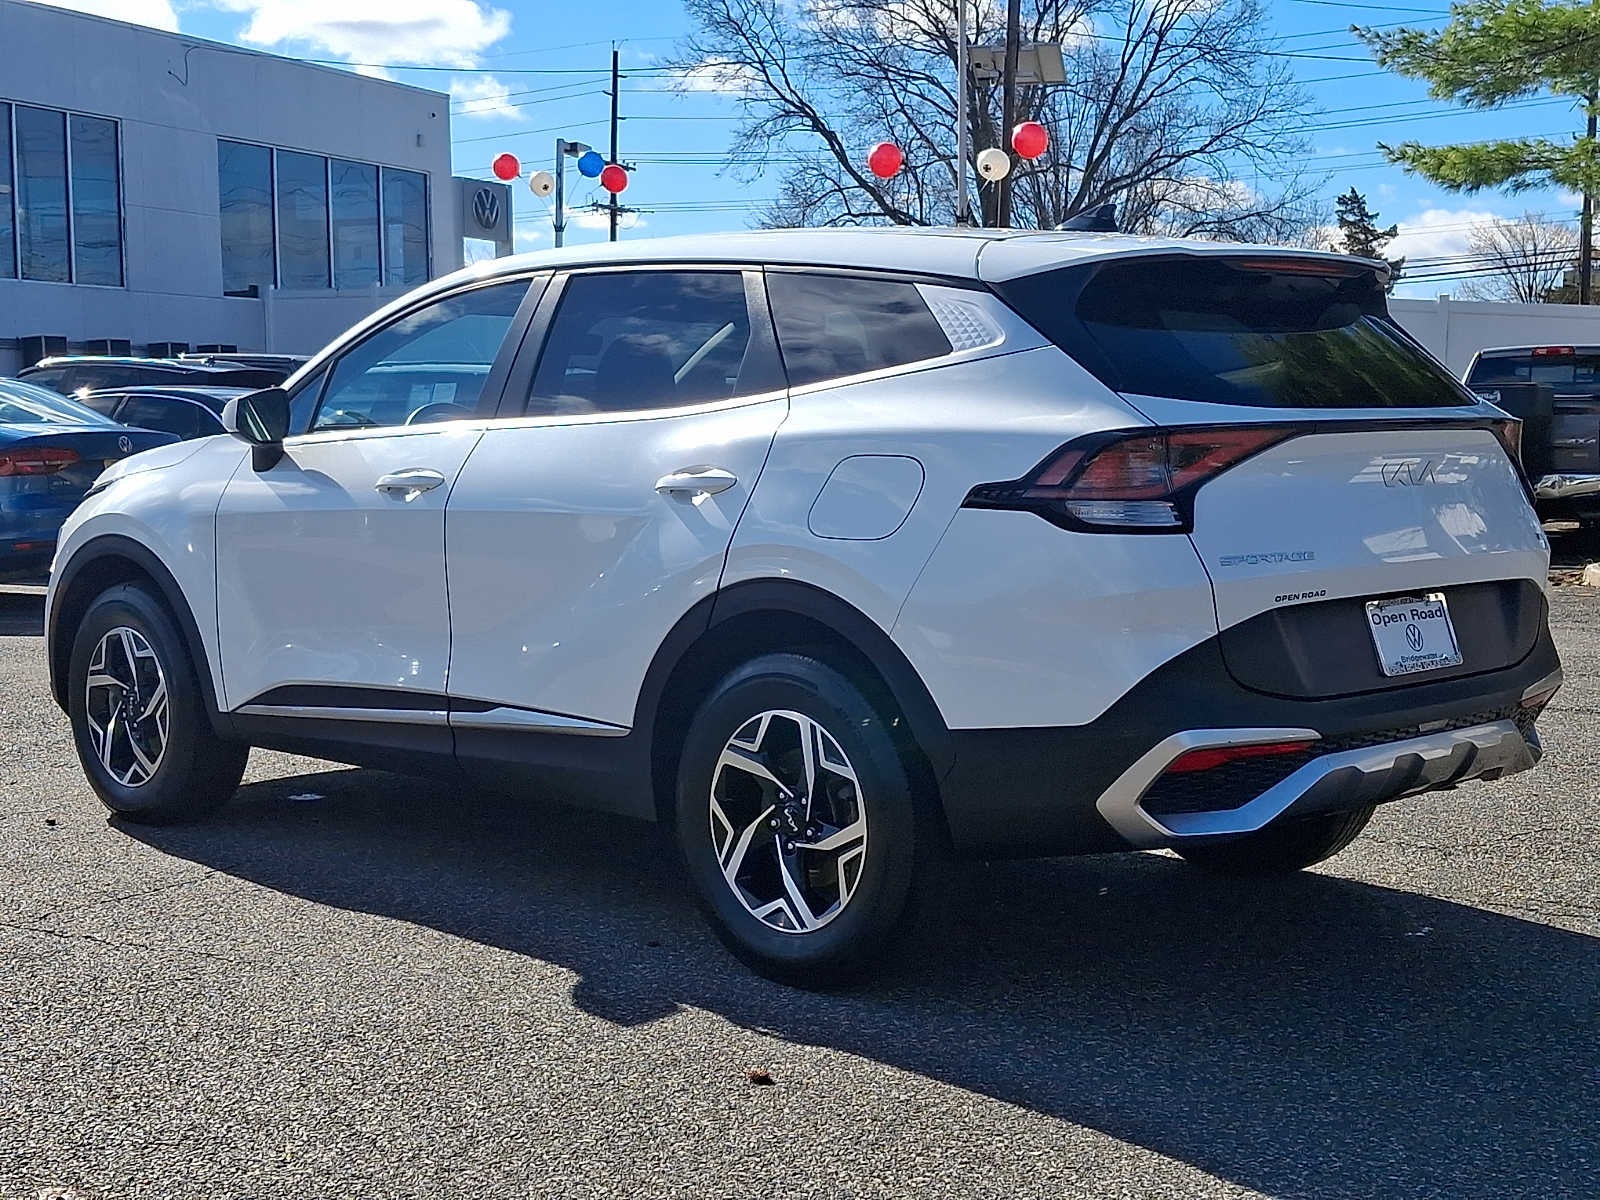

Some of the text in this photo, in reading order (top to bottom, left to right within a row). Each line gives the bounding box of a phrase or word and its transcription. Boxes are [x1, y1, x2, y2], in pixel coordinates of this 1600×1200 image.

[1381, 460, 1436, 488] KIA
[1219, 550, 1315, 567] SPORTAGE
[1274, 589, 1327, 603] OPEN ROAD
[1371, 606, 1443, 627] Open Road
